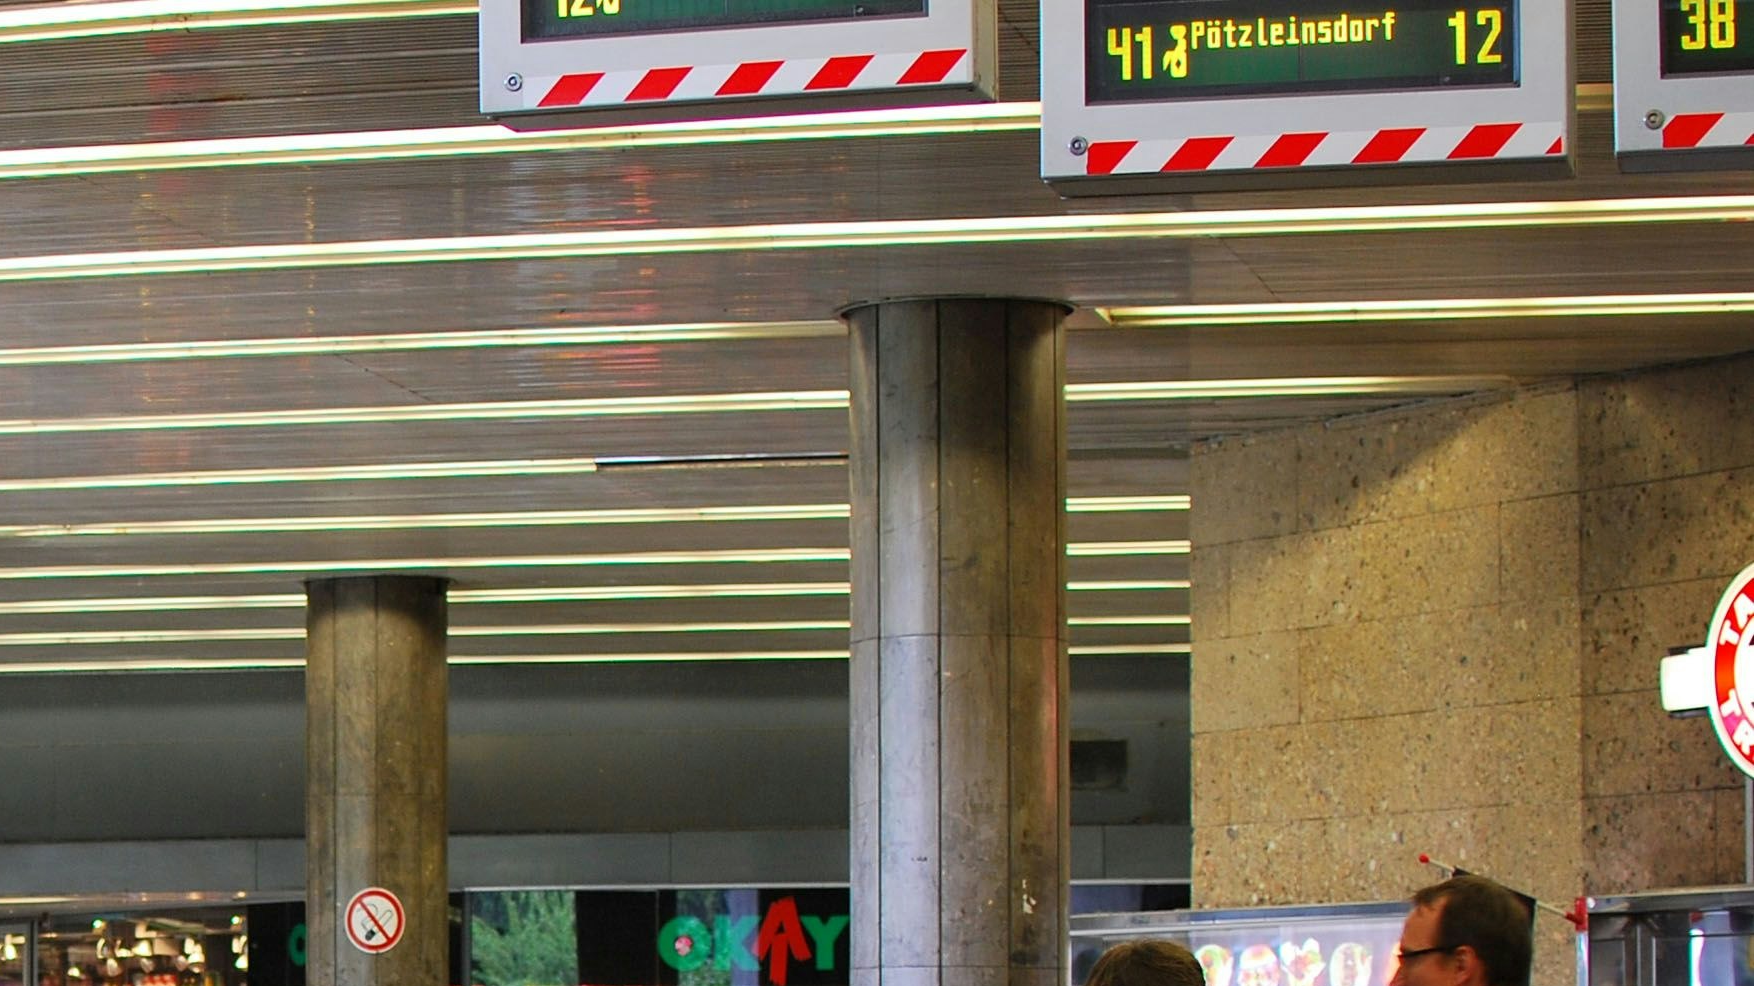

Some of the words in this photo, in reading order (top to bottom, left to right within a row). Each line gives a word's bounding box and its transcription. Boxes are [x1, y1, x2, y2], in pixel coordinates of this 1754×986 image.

[1106, 26, 1153, 81] 41
[1190, 11, 1396, 50] Pötzleinsdorf
[1447, 9, 1503, 66] 12
[1679, 0, 1736, 51] 38
[1720, 688, 1754, 762] TR
